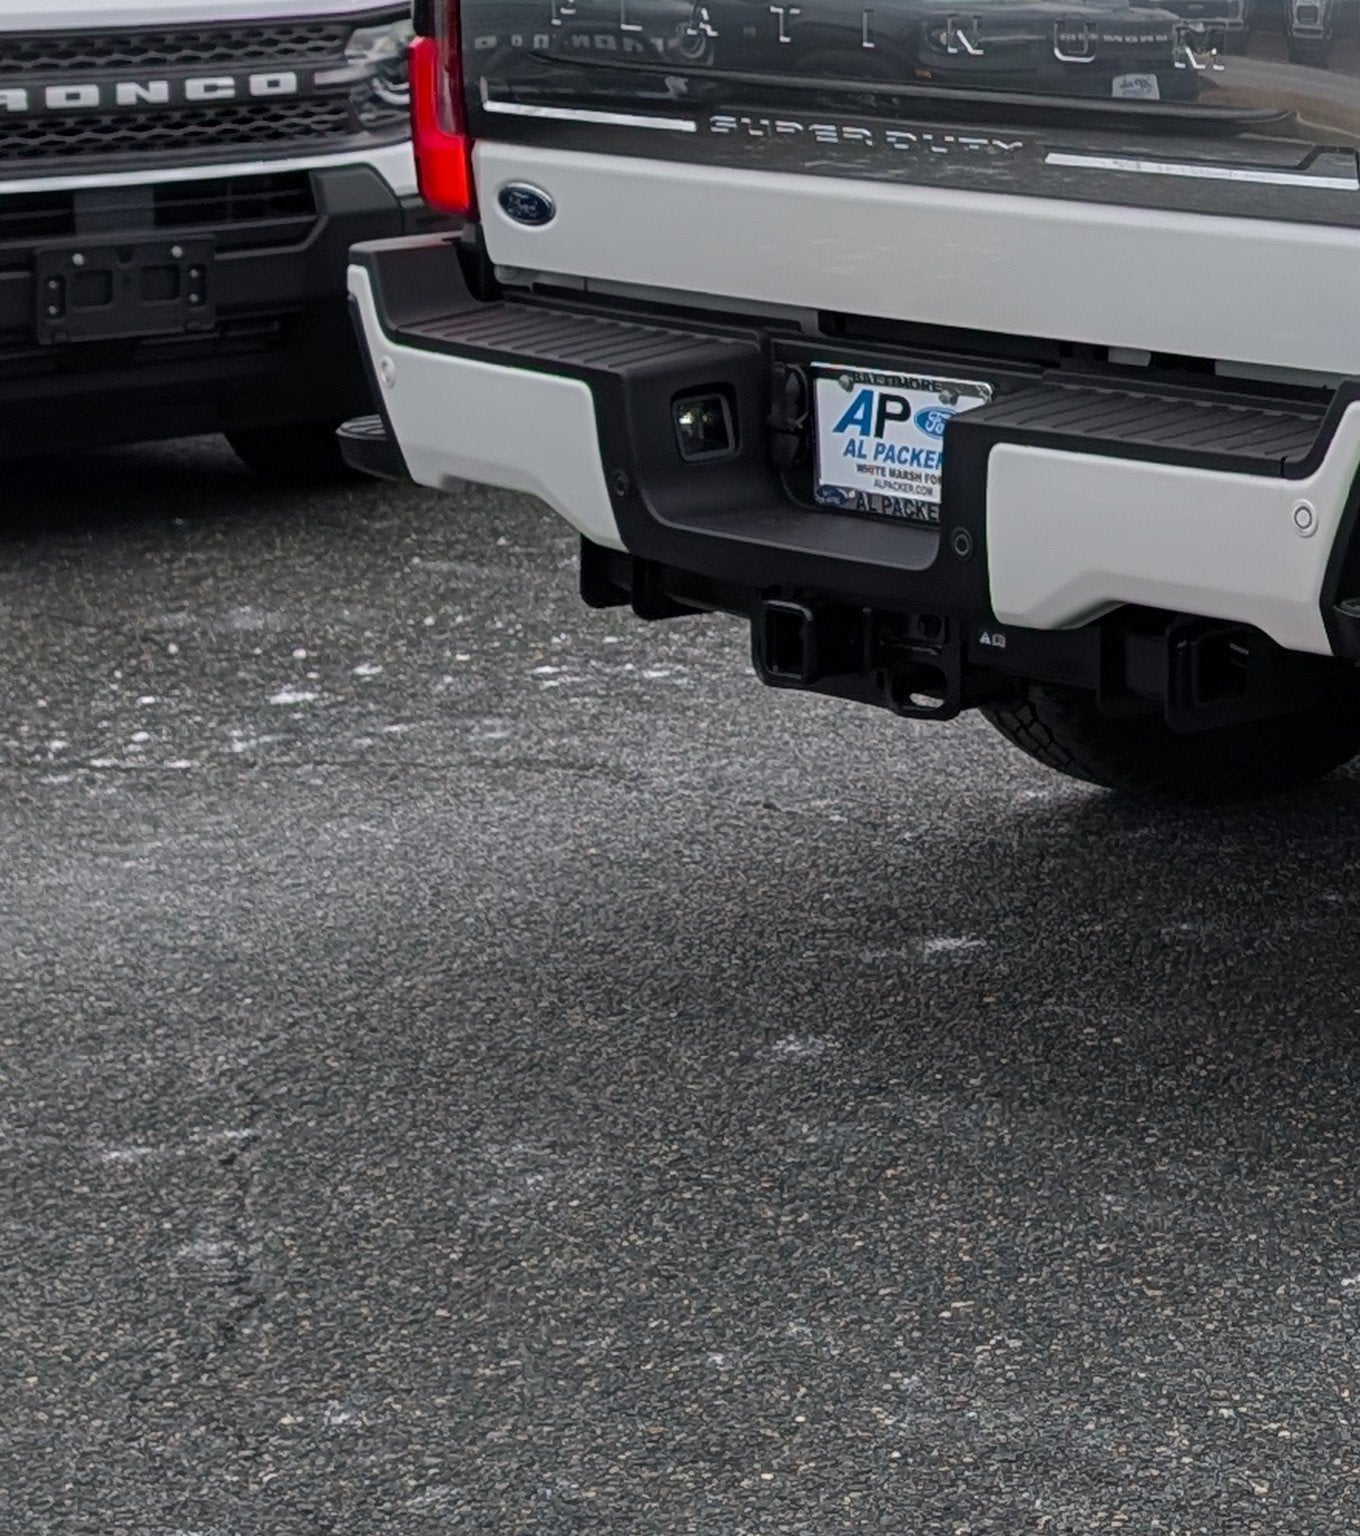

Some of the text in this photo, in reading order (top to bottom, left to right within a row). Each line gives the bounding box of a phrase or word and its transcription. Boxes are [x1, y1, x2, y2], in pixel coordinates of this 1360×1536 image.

[0, 71, 297, 112] RONCO
[709, 115, 874, 147] SUPER
[832, 389, 951, 439] AP Fo
[843, 438, 867, 459] AL
[856, 463, 942, 486] WHITE MARSH FO
[856, 490, 877, 513] AL
[880, 495, 940, 522] PACKE
